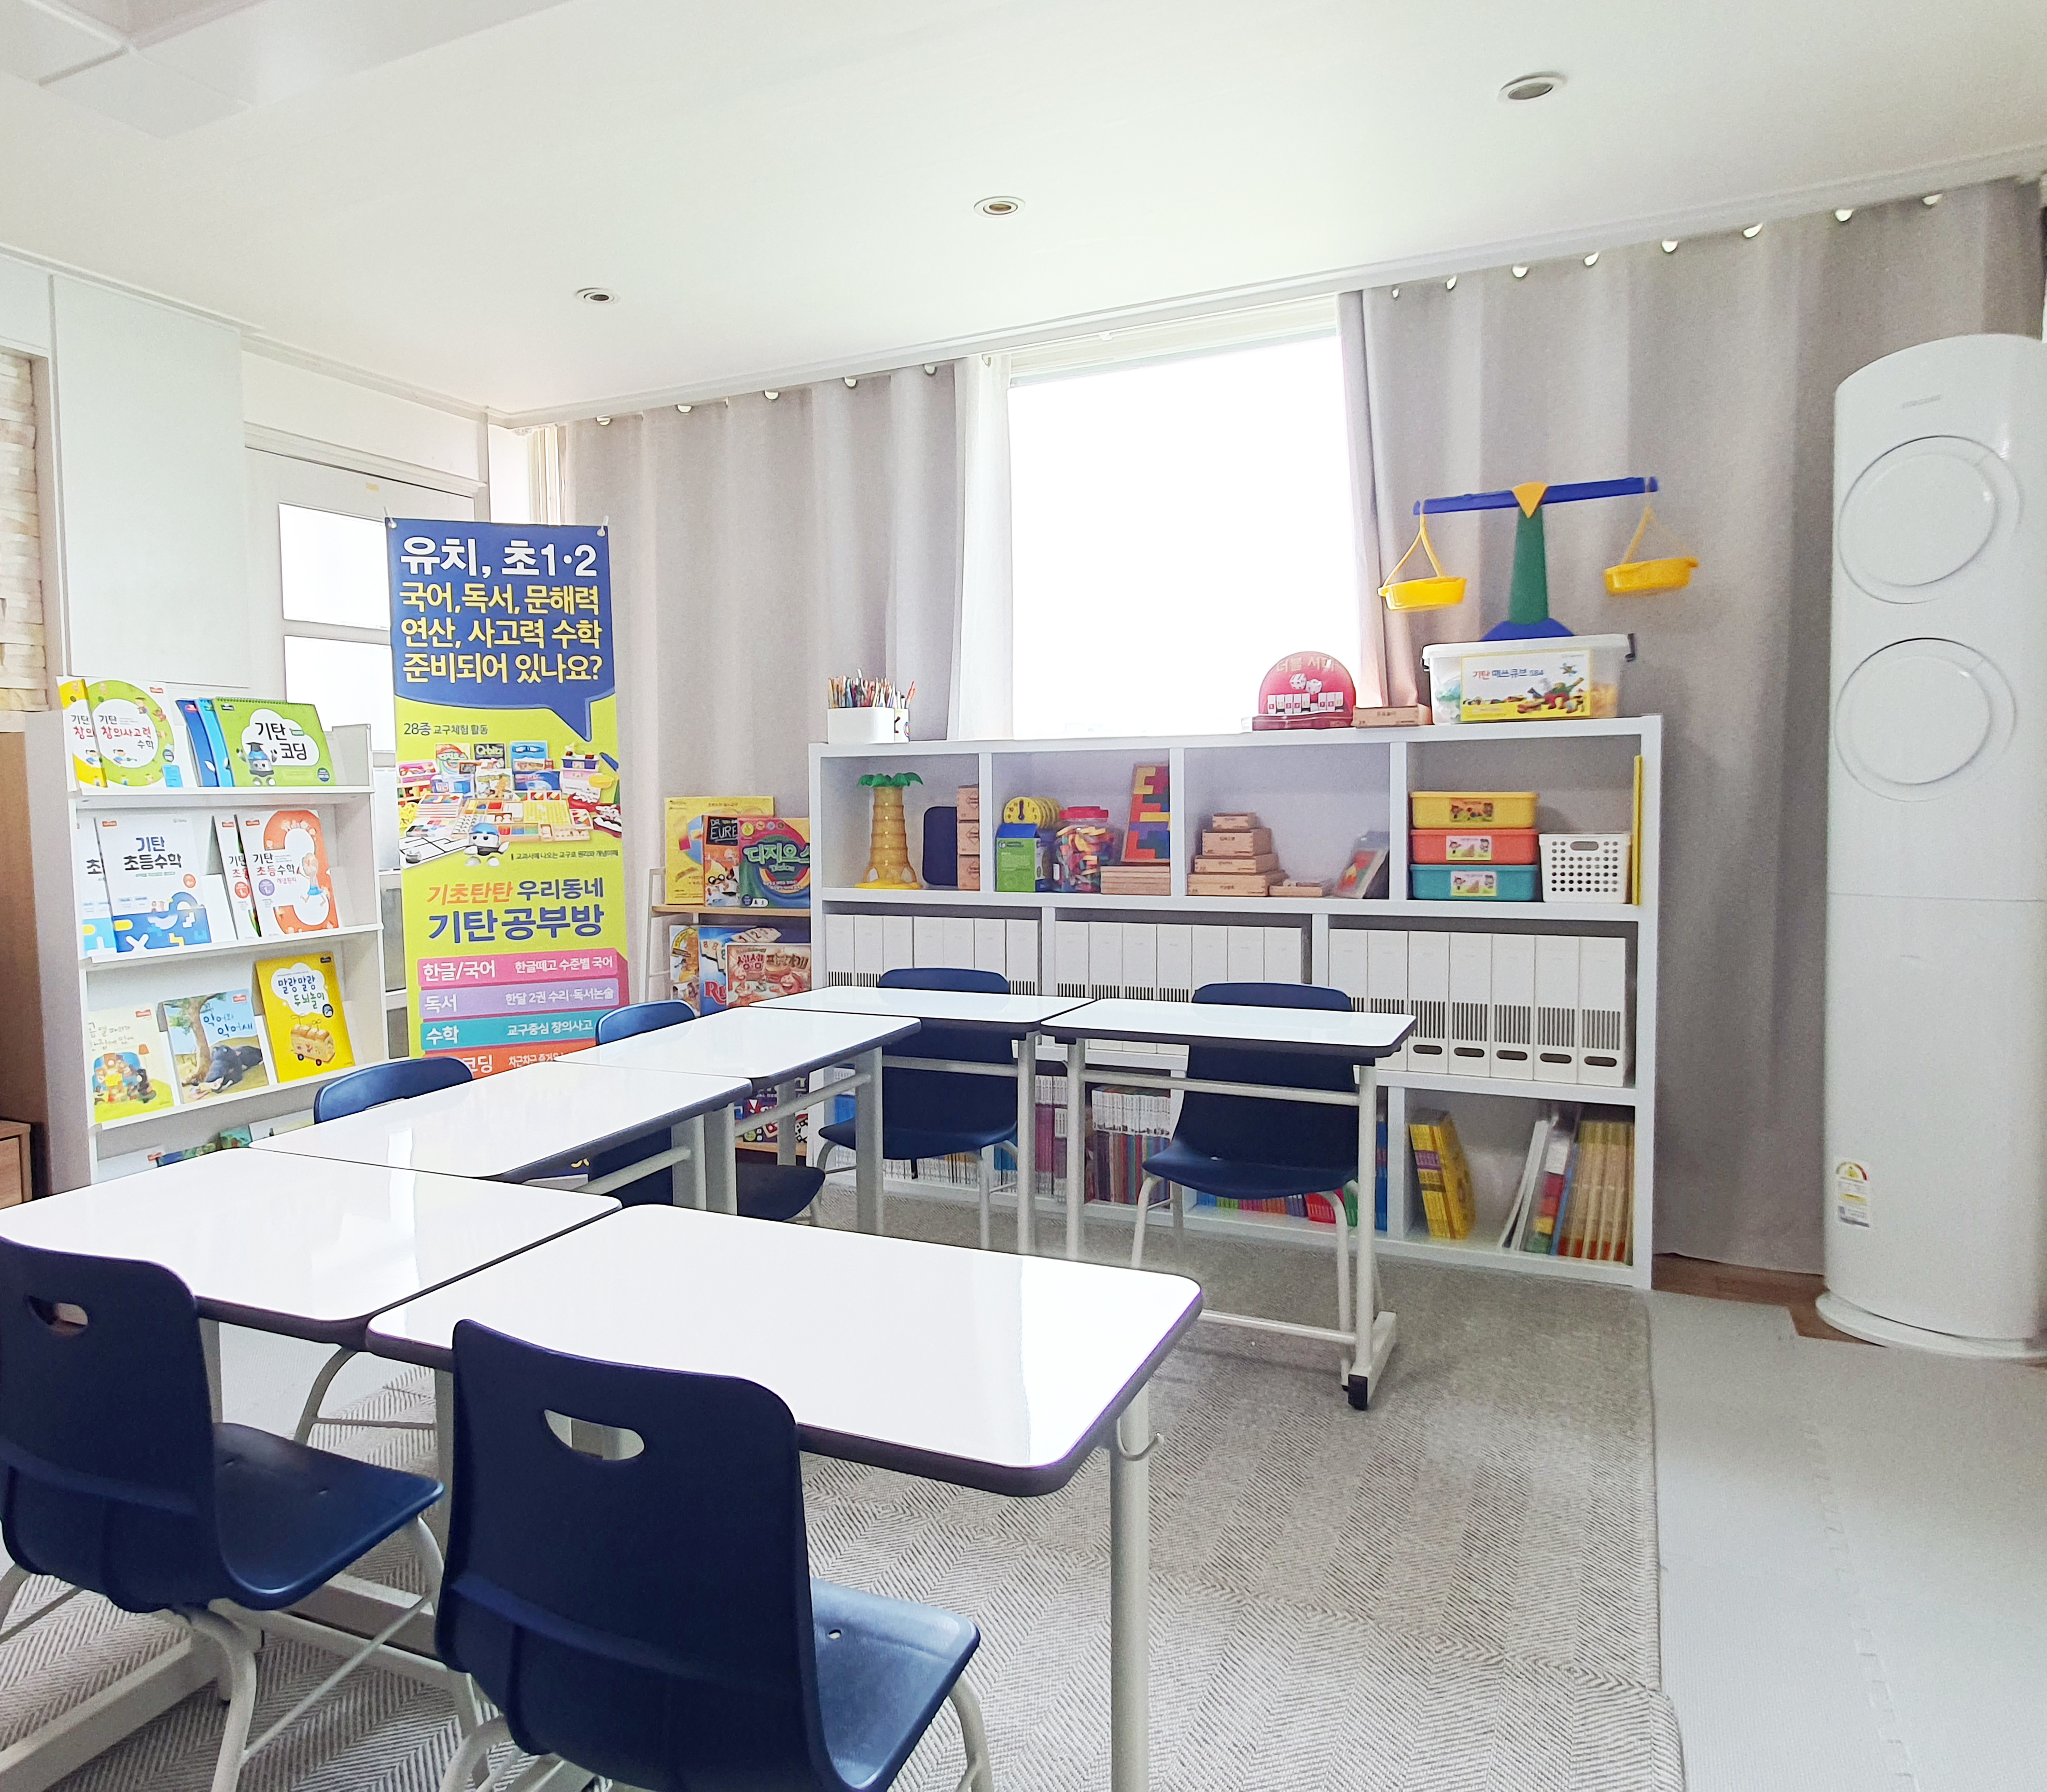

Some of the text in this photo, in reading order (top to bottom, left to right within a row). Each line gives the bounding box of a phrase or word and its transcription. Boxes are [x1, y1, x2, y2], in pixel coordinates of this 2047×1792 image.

[400, 537, 491, 578] 유치,
[401, 617, 603, 649] 연산, 사고력 수학
[402, 652, 604, 683] 준비되어 있나요?
[1473, 670, 1491, 679] 기탄
[98, 715, 118, 724] 기탄
[102, 726, 151, 739] 창의사고력
[255, 722, 287, 740] 기탄
[403, 722, 431, 736] 28종
[137, 740, 154, 749] 수학
[279, 743, 307, 760] 코딩
[135, 836, 165, 852] 기탄
[123, 853, 183, 871] 초등수학
[253, 853, 274, 864] 기탄
[427, 877, 604, 905] 기초탄탄 우리동네
[428, 904, 604, 943] 기탄 공부방
[422, 955, 613, 982] 한글/국어 한글떼고 수준별 국어
[278, 975, 316, 995] 말랑말랑
[293, 991, 325, 1010] 두뇌놀이
[424, 994, 458, 1013] 독서
[505, 991, 527, 1006] 한달
[528, 990, 546, 1003] 2권
[426, 1019, 594, 1046] 수학 교구중심 창의사고
